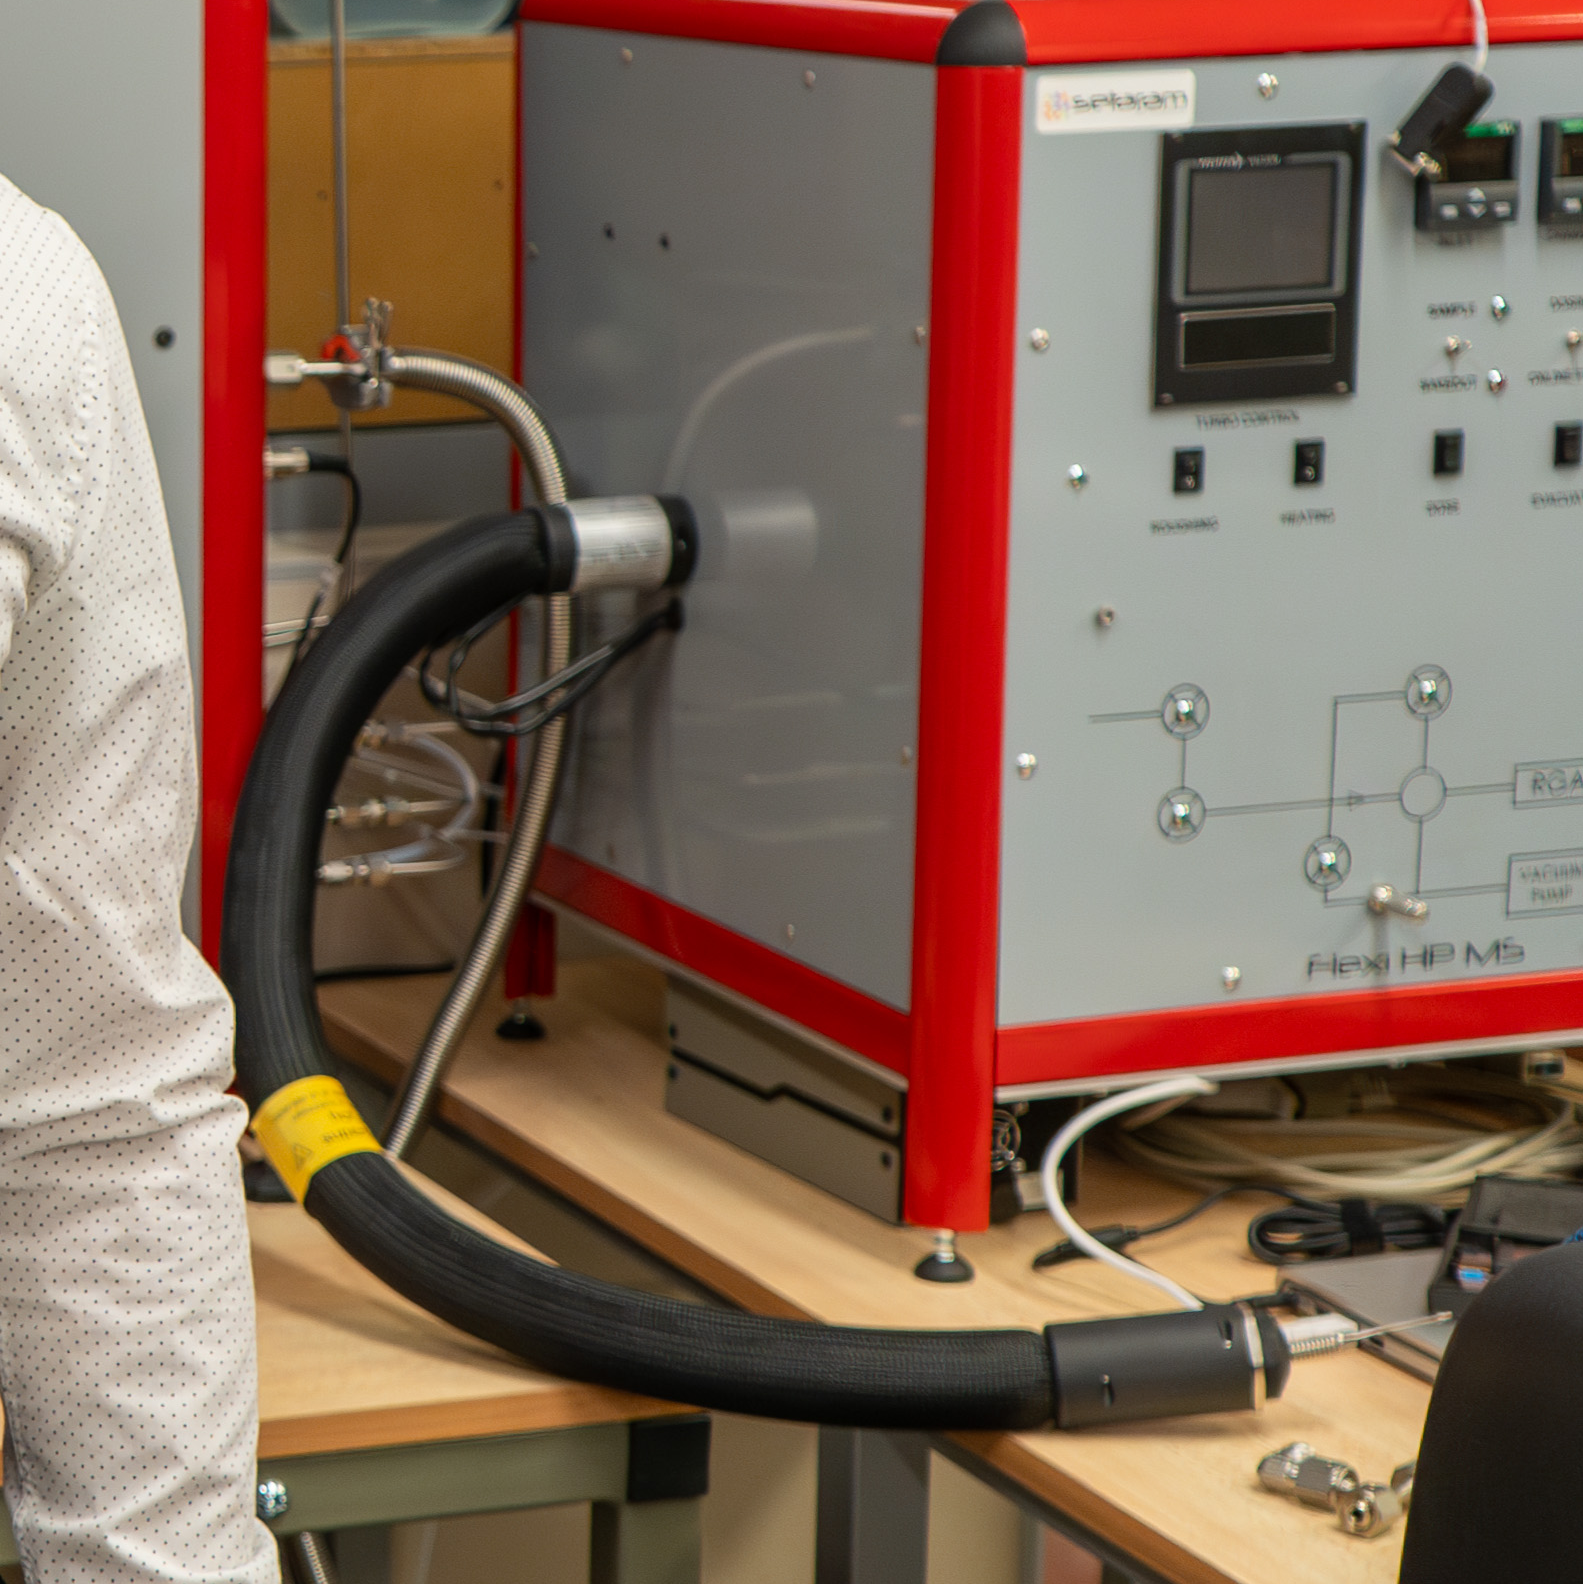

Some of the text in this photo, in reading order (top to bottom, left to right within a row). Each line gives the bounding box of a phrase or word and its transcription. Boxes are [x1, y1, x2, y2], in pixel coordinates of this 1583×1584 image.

[1072, 90, 1188, 116] setaram
[1307, 936, 1526, 980] Flexi HP MS
